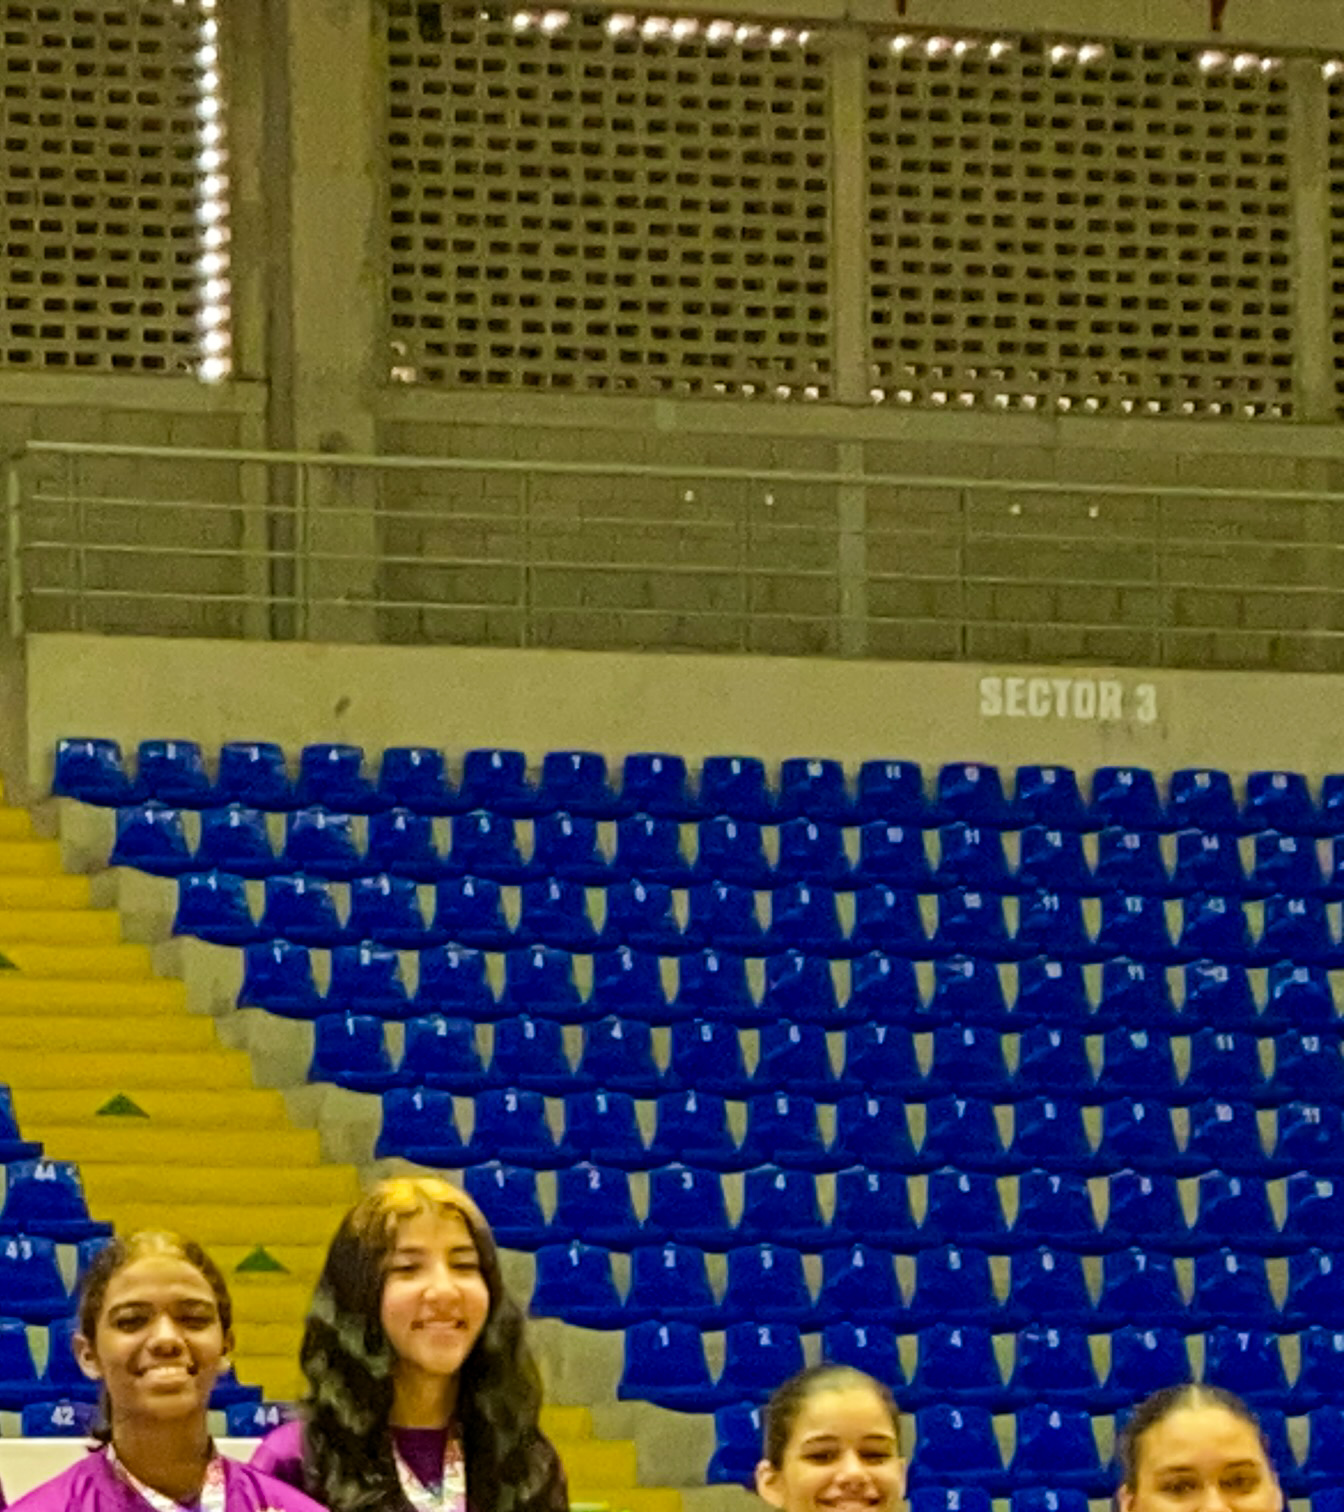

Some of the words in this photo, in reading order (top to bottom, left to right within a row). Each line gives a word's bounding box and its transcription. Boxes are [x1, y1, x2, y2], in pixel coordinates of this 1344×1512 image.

[980, 676, 1122, 719] SECTOR
[1136, 683, 1157, 723] 3
[413, 1093, 422, 1109] 1
[506, 1094, 516, 1111] 2
[34, 1162, 56, 1180] 44
[495, 1169, 504, 1187] 1
[589, 1169, 600, 1189] 2
[682, 1172, 692, 1188] 3
[868, 1174, 878, 1191] 5
[1050, 1176, 1060, 1192] 7
[6, 1241, 31, 1259] 43
[569, 1248, 578, 1265] 1
[664, 1250, 674, 1267] 2
[1136, 1255, 1145, 1270] 7
[659, 1327, 668, 1345] 1
[759, 1328, 770, 1345] 2
[856, 1329, 866, 1347] 3
[951, 1331, 961, 1346] 4
[1238, 1333, 1249, 1350] 7
[51, 1406, 74, 1425] 42
[951, 1411, 962, 1428] 3
[948, 1490, 959, 1510] 2
